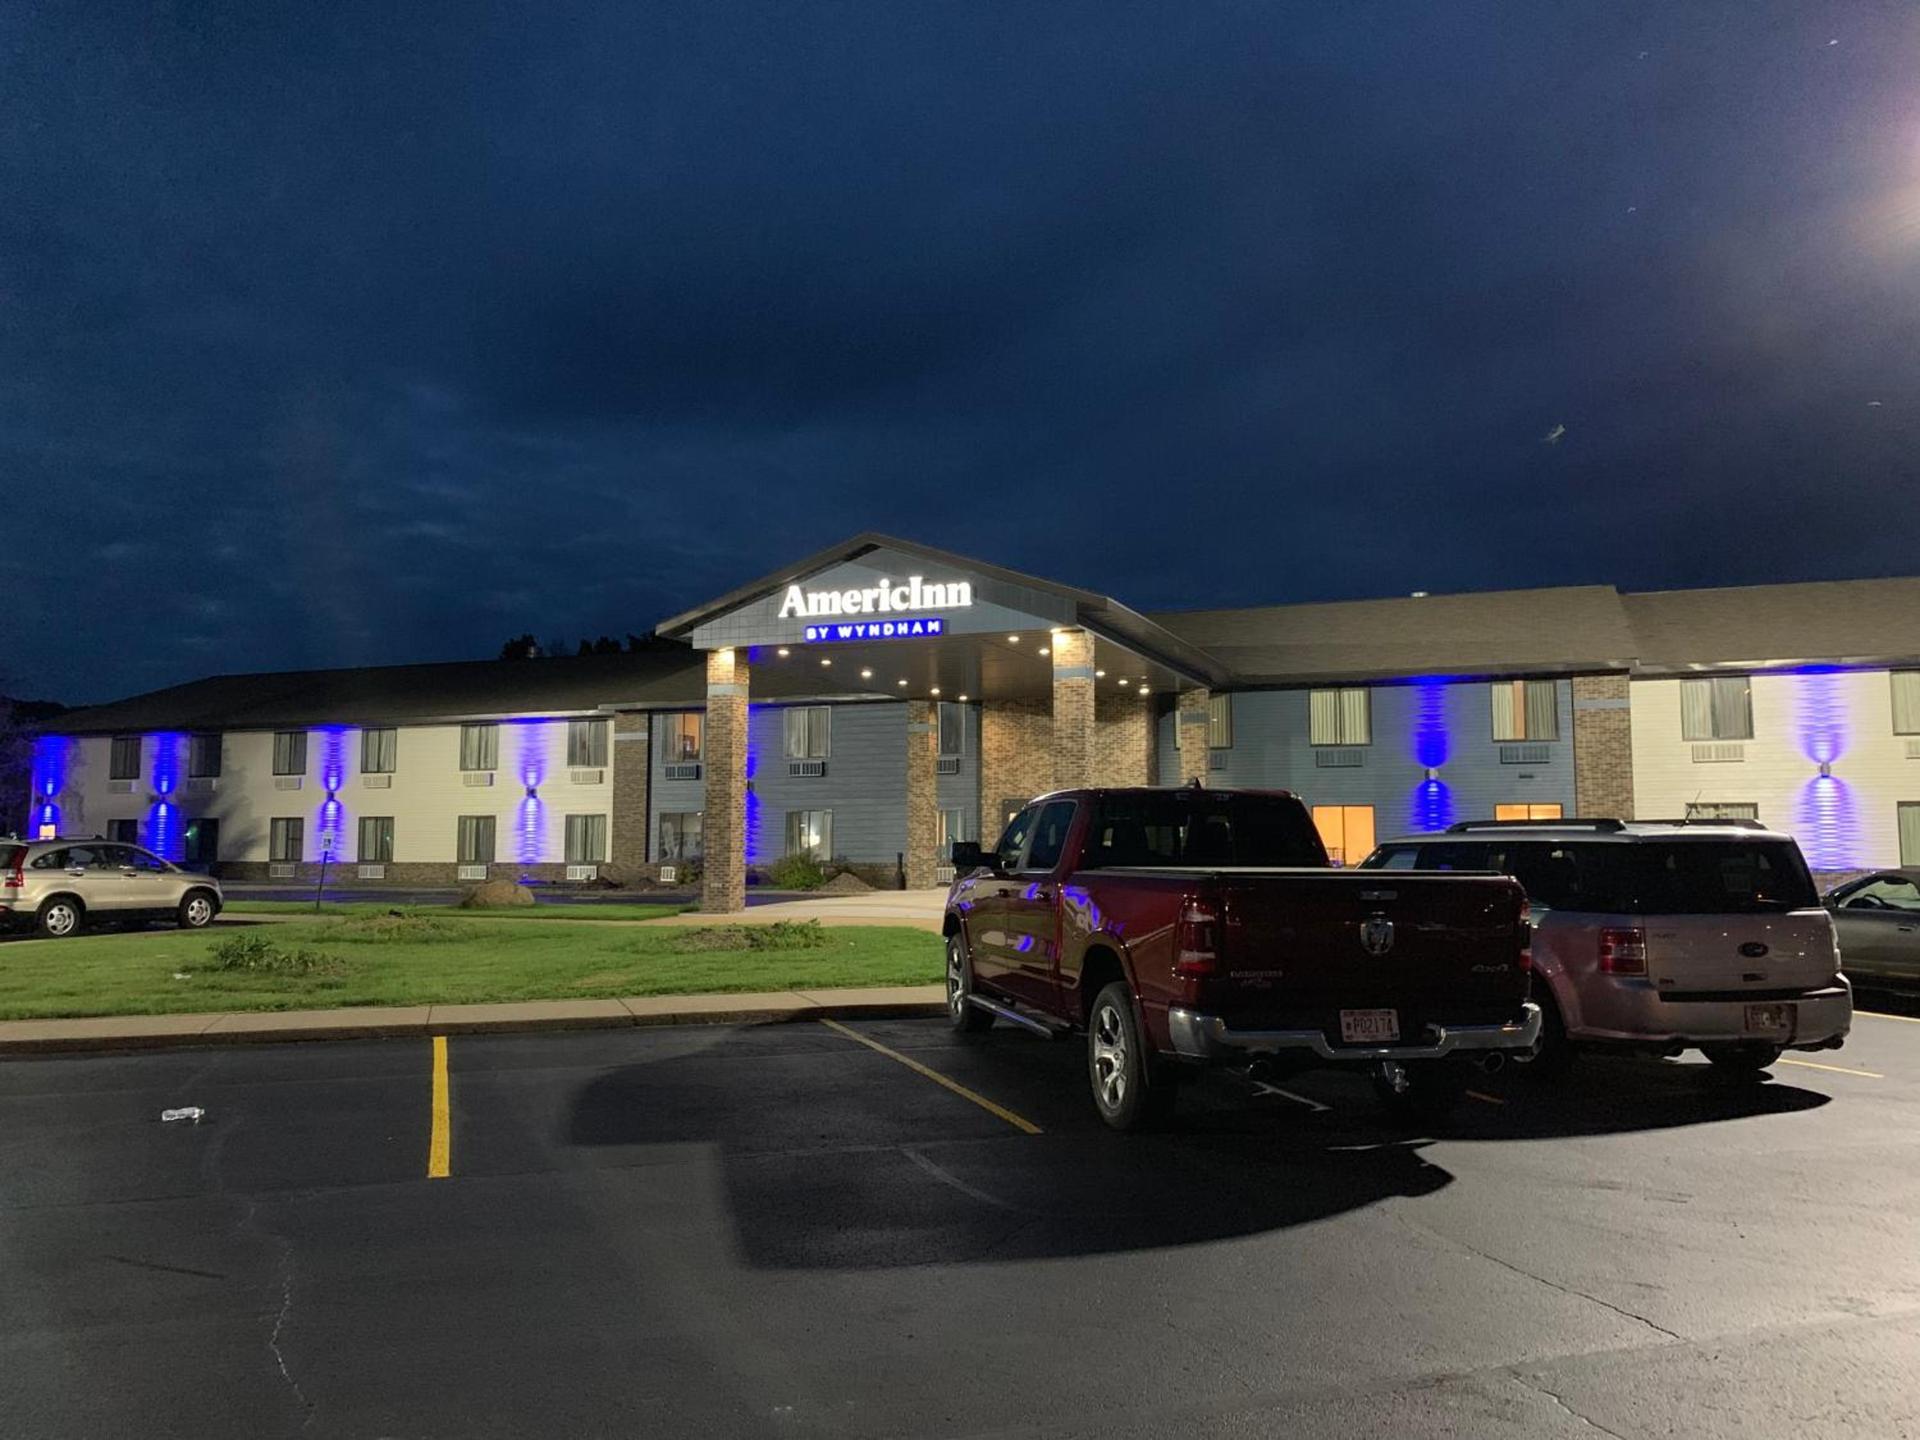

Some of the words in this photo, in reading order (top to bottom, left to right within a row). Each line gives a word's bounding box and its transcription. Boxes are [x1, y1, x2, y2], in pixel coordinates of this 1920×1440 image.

[778, 576, 972, 618] AmericInn
[806, 627, 829, 640] BY
[838, 620, 941, 638] WYNDHAM
